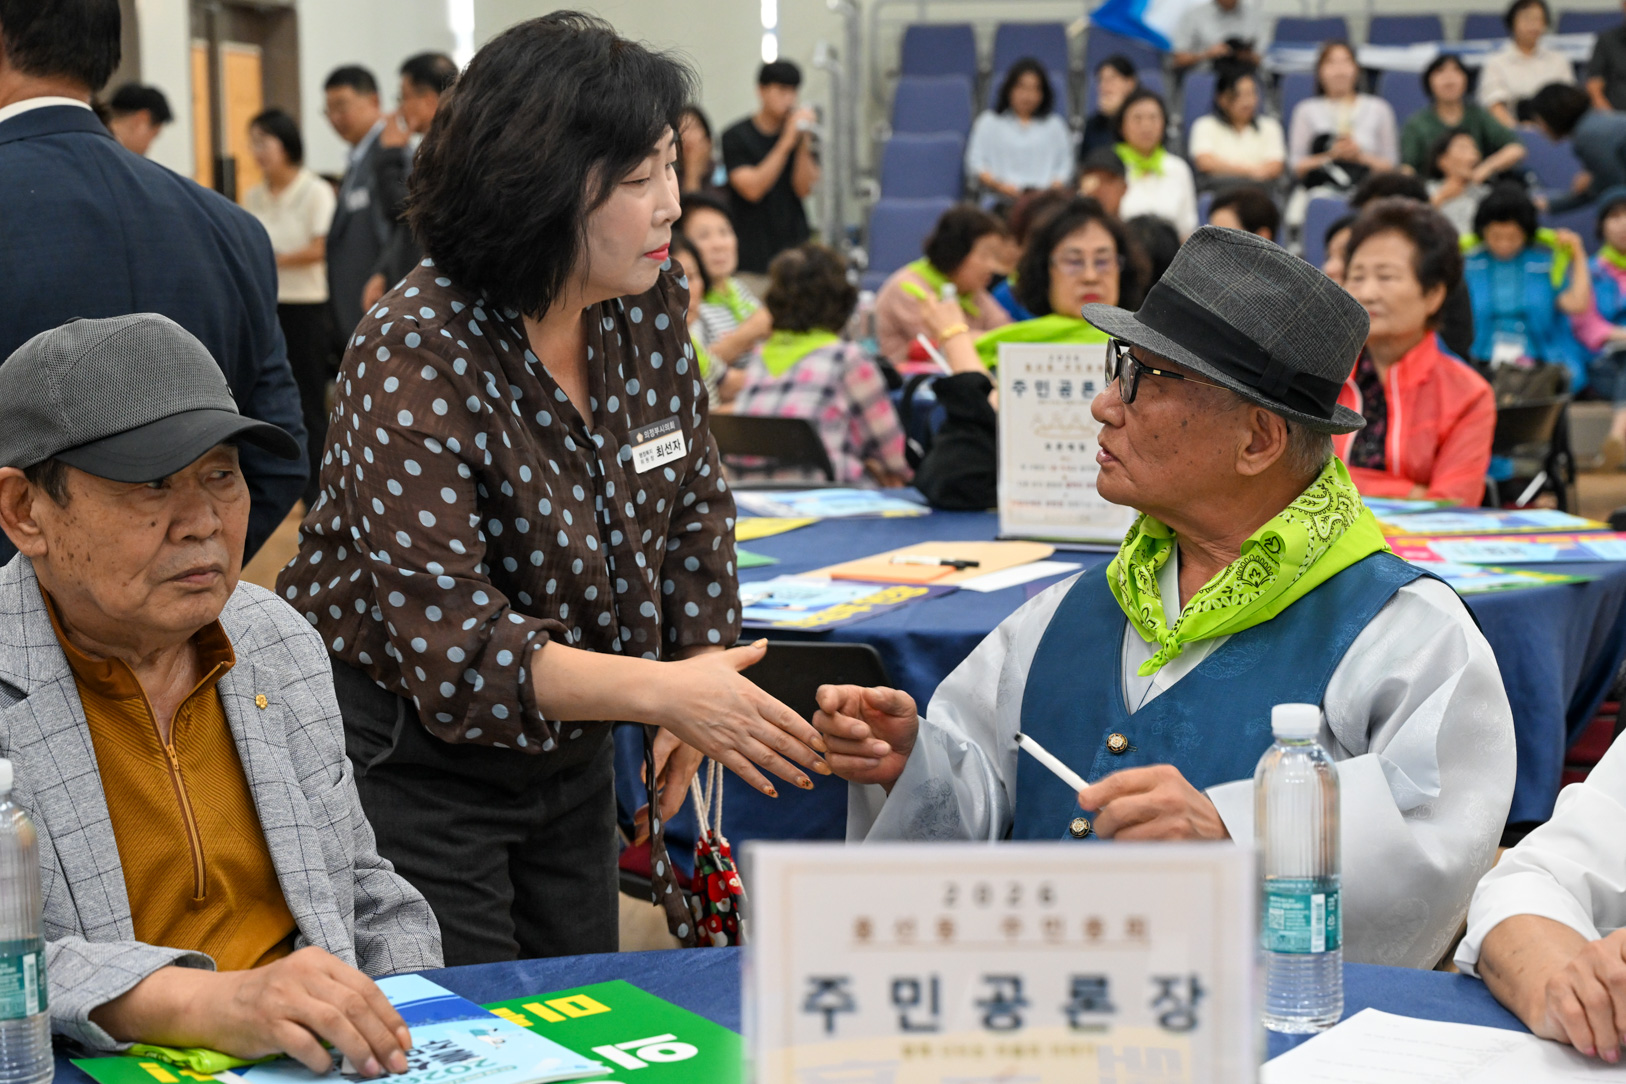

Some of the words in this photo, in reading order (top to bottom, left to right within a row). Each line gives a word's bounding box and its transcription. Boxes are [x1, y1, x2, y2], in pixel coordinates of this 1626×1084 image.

[644, 421, 676, 438] 의정부시의회
[656, 438, 682, 458] 최선자
[802, 972, 1207, 1032] 주민공론장
